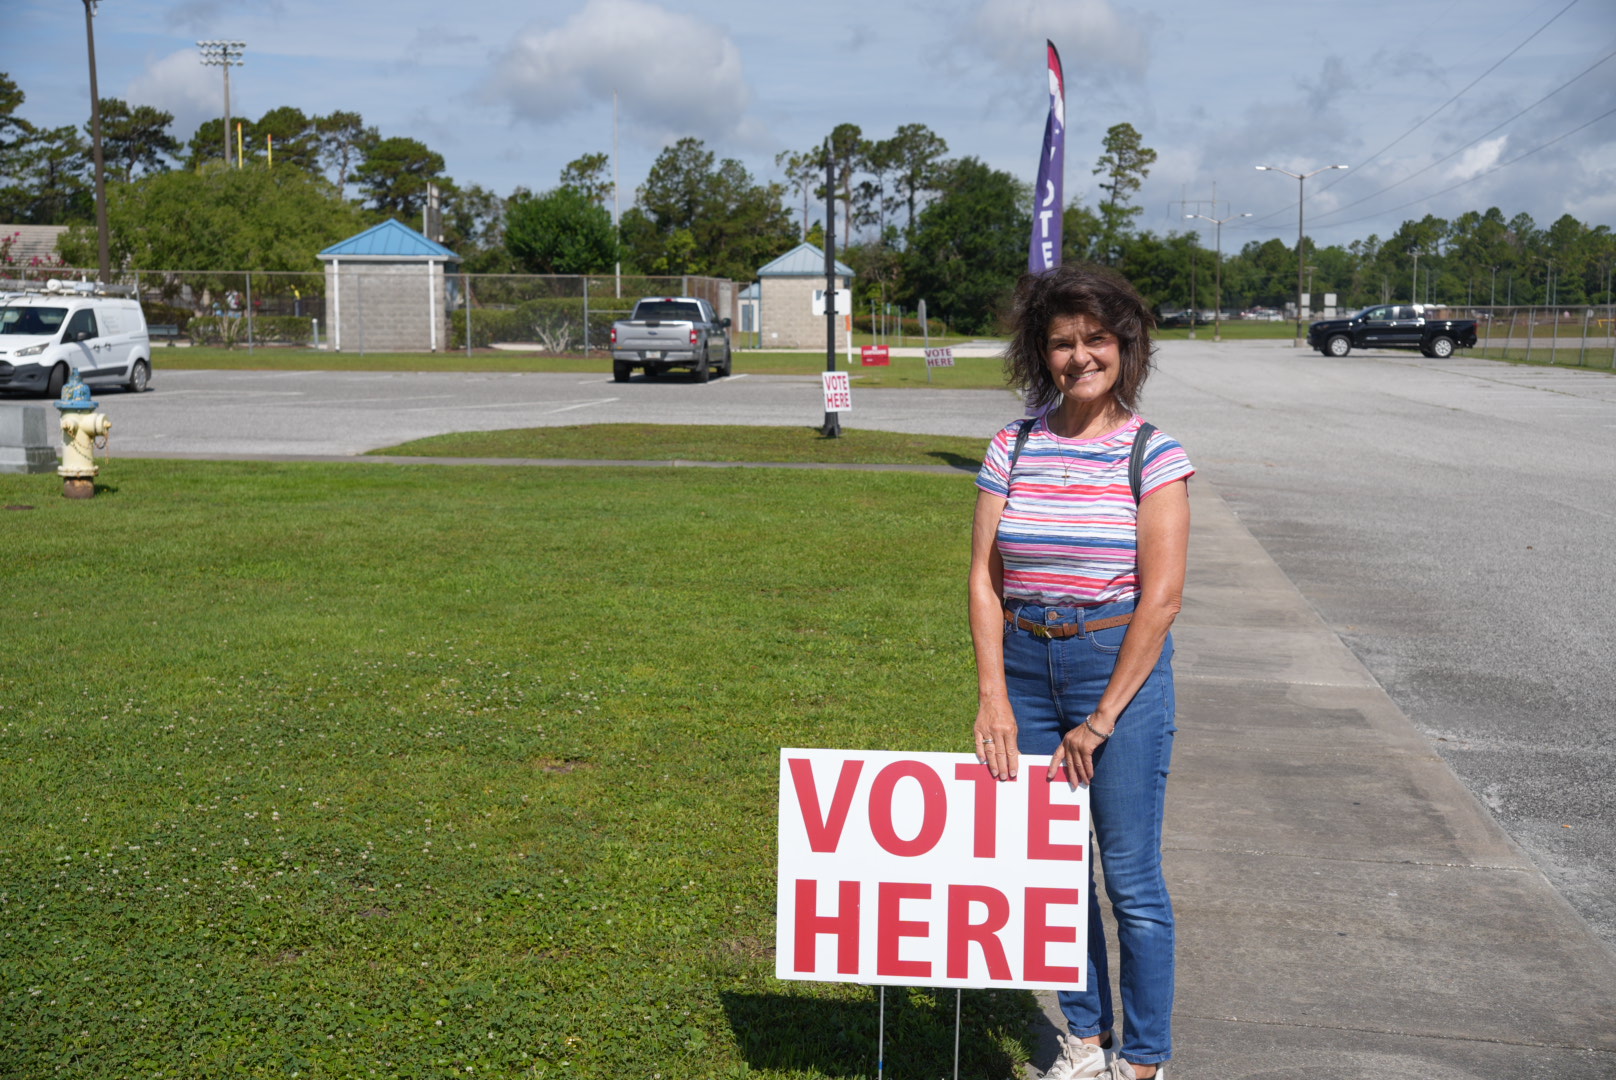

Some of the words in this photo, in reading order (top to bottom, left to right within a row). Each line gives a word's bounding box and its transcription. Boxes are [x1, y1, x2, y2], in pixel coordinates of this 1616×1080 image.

[925, 348, 952, 358] VOTE
[927, 357, 953, 367] HERE
[825, 375, 848, 391] VOTE
[826, 392, 850, 408] HERE
[788, 758, 1083, 861] VOTE
[793, 879, 1079, 983] HERE
